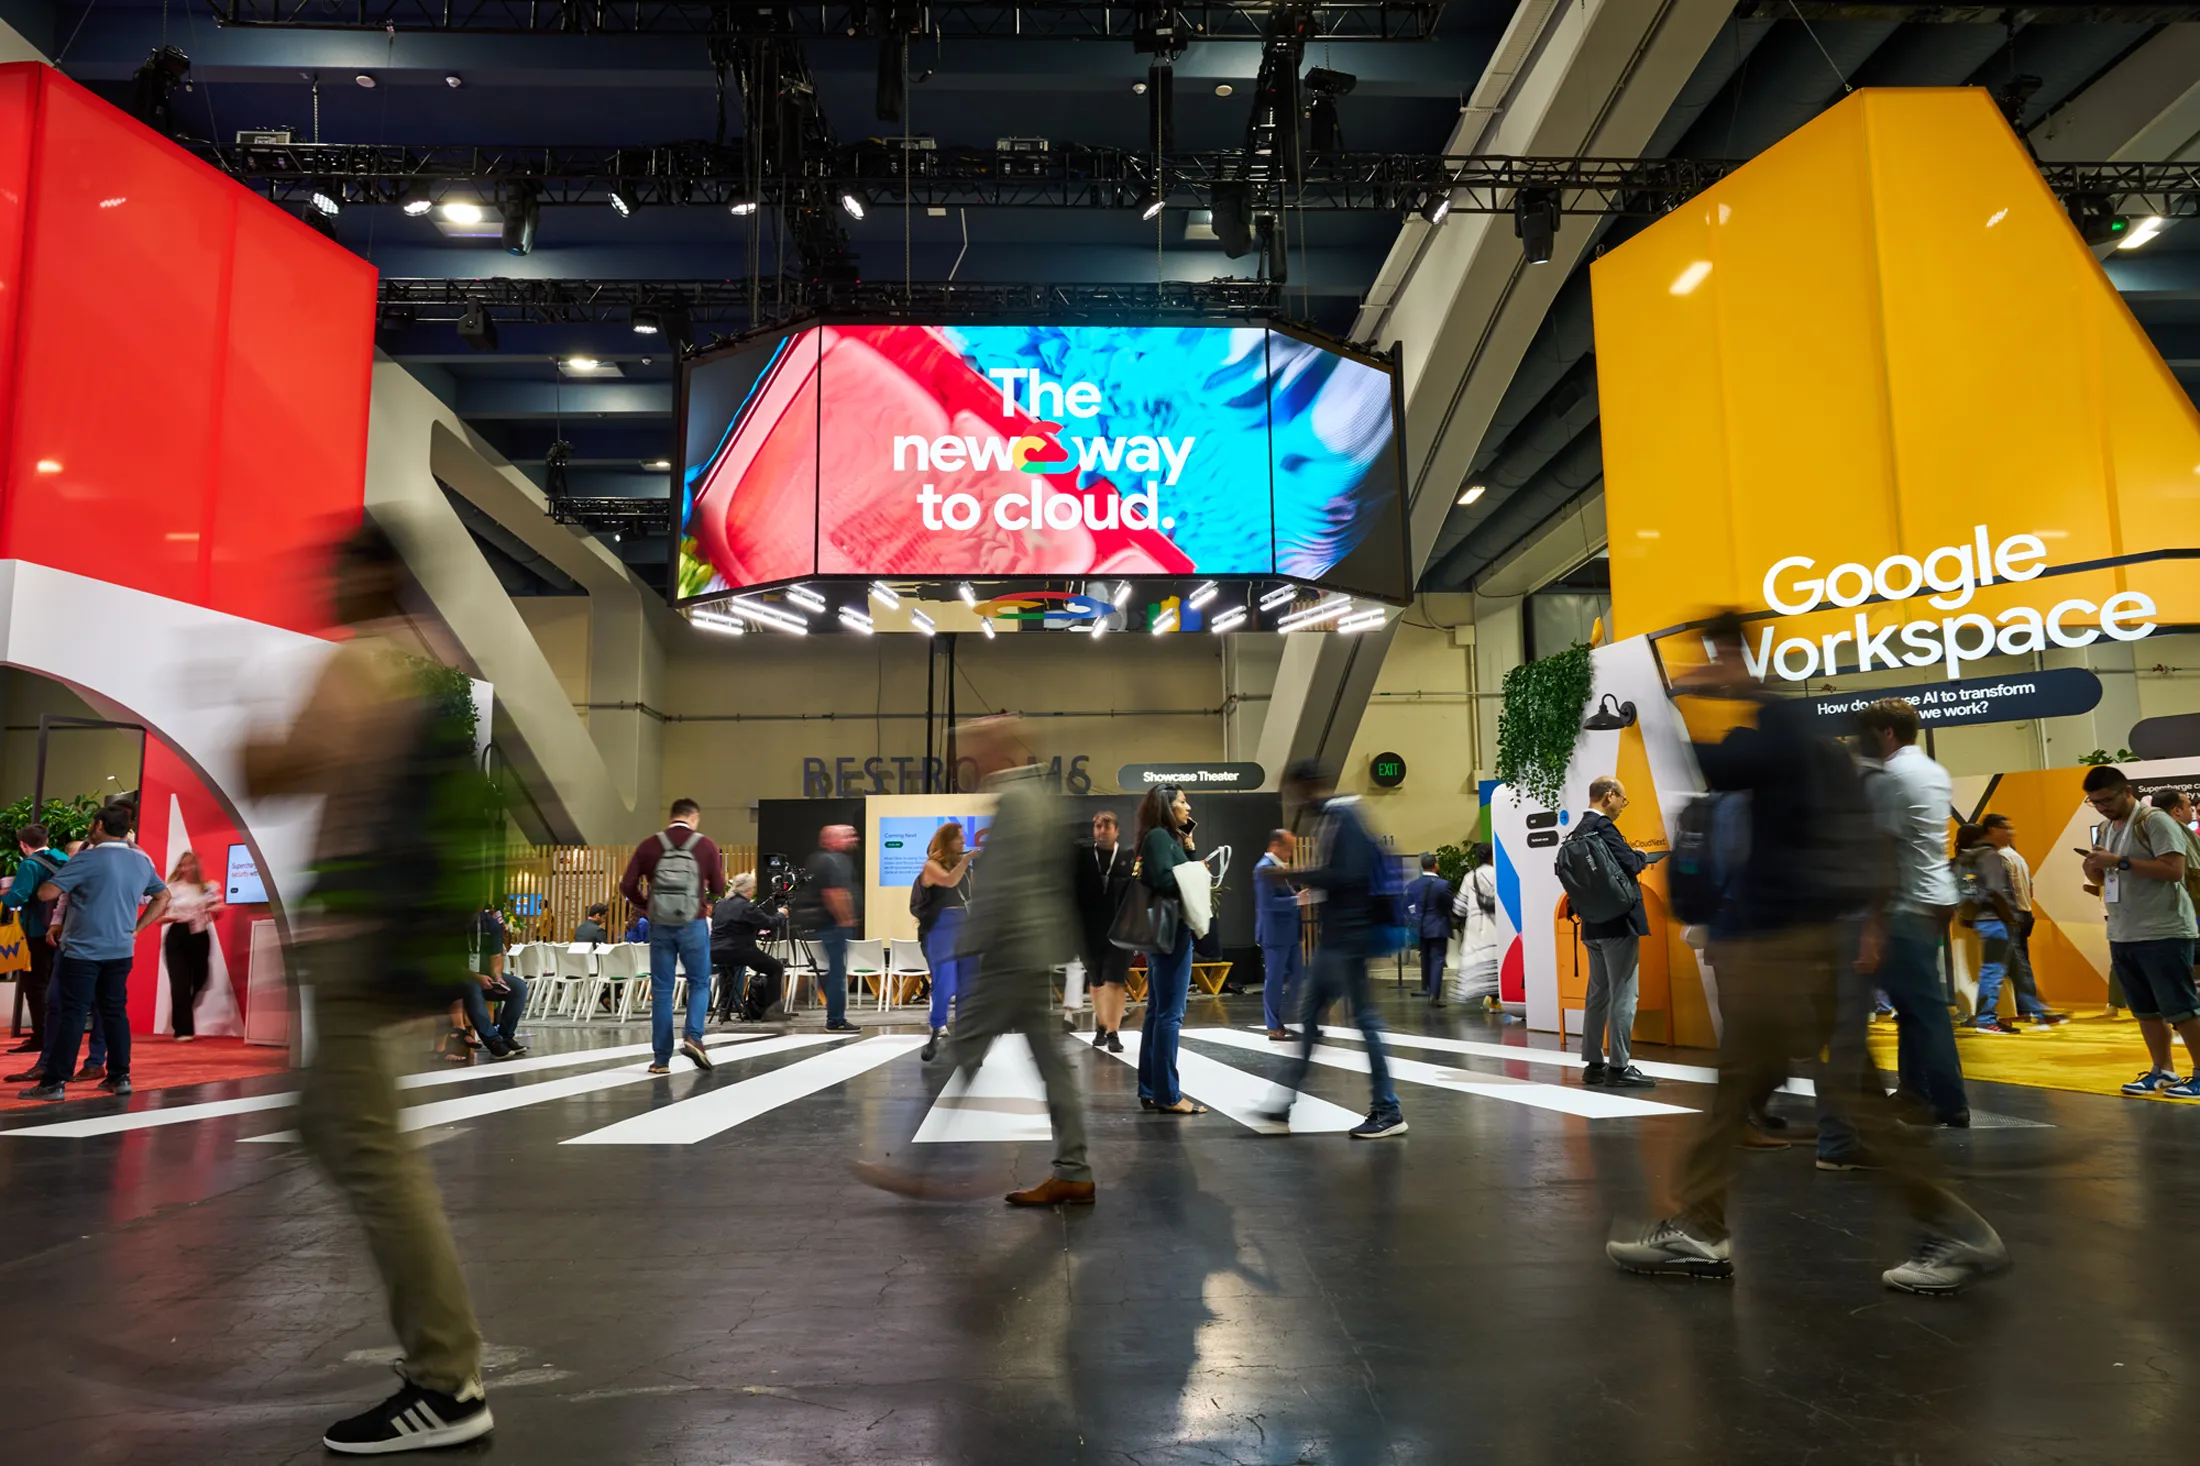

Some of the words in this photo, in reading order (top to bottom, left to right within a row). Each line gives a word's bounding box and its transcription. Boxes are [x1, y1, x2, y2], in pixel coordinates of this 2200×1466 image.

[988, 367, 1102, 419] The
[893, 434, 1022, 472] new
[1070, 435, 1196, 486] way
[916, 483, 981, 531] to
[993, 479, 1176, 531] cloud.
[1762, 524, 2047, 616] Google
[1817, 702, 1848, 715] How
[1850, 699, 1869, 712] do
[1901, 695, 1920, 706] se
[1923, 690, 1938, 705] AI
[1940, 690, 1957, 703] to
[1959, 683, 2036, 700] transform
[1919, 708, 1941, 719] we
[1943, 701, 1989, 717] work?
[1143, 771, 1198, 783] Showcase
[1197, 770, 1240, 782] Theater
[1378, 762, 1400, 777] EXIT
